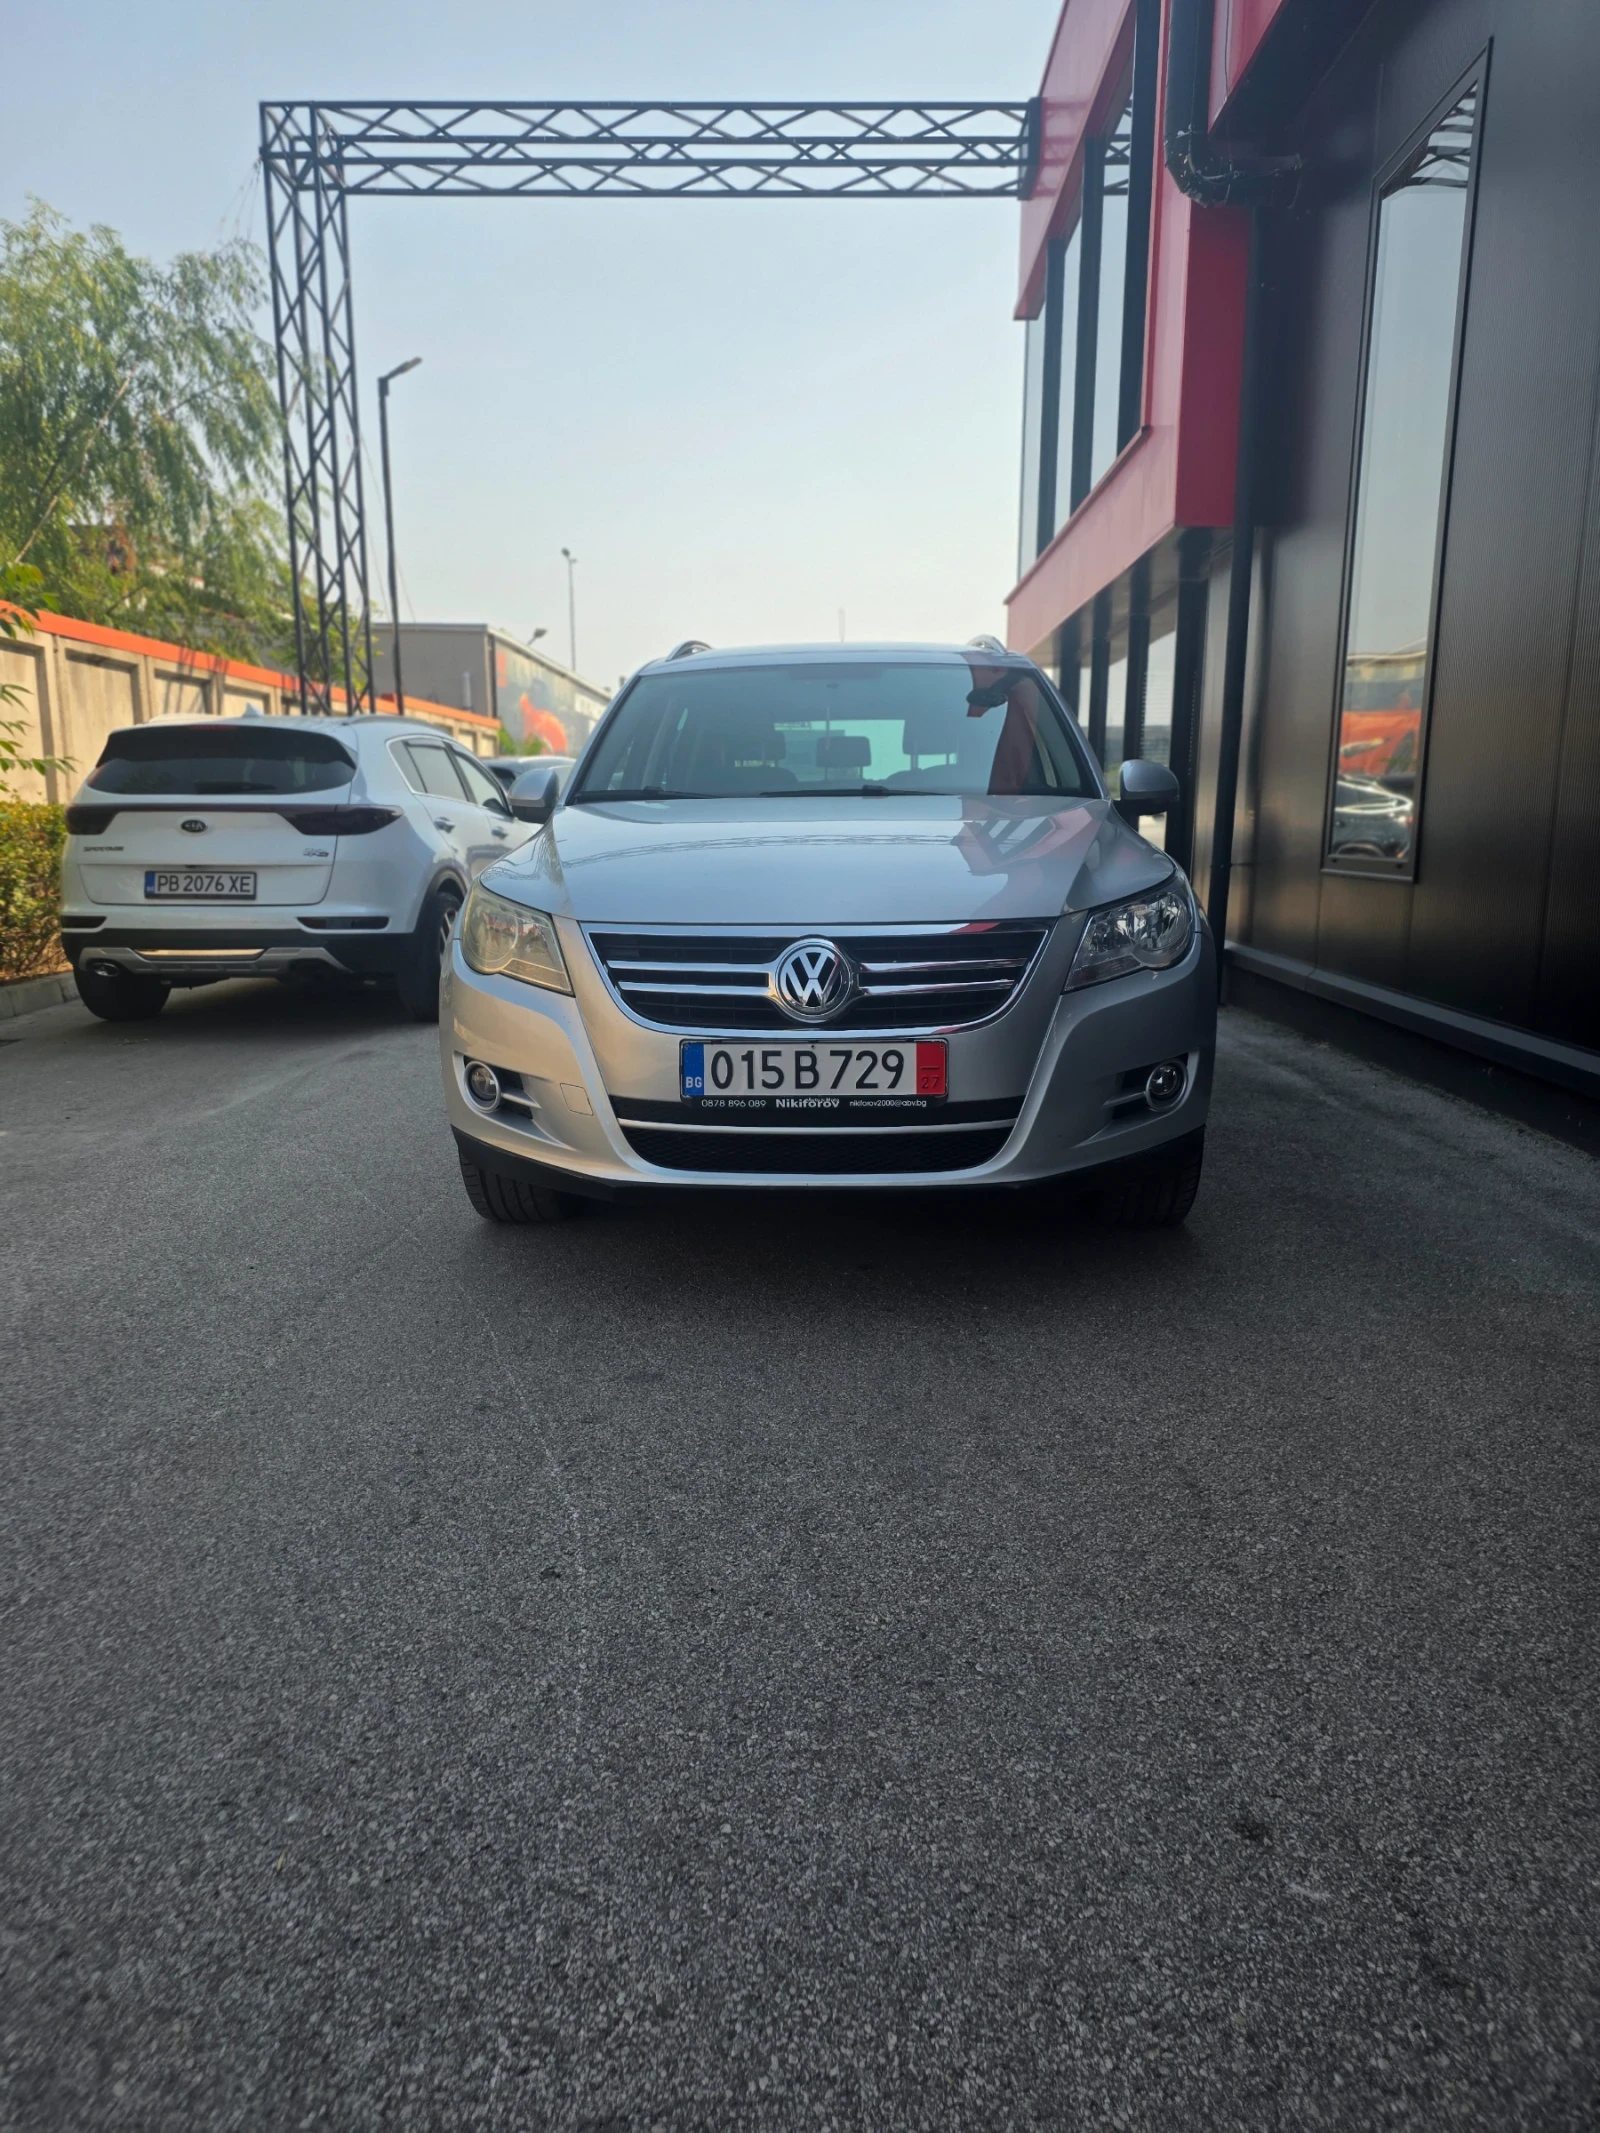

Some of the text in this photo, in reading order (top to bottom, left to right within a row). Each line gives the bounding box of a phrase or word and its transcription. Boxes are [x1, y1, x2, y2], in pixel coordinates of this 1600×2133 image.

[157, 875, 180, 892] PB
[183, 875, 225, 892] 2076
[229, 876, 251, 893] XE
[686, 1076, 703, 1089] BG
[921, 1075, 939, 1089] 27
[701, 1099, 726, 1108] 0878
[728, 1099, 747, 1108] 896
[748, 1099, 767, 1108] 089
[775, 1098, 841, 1108] Nikiforov
[850, 1099, 927, 1108] nikiforov2000@abv.bg
